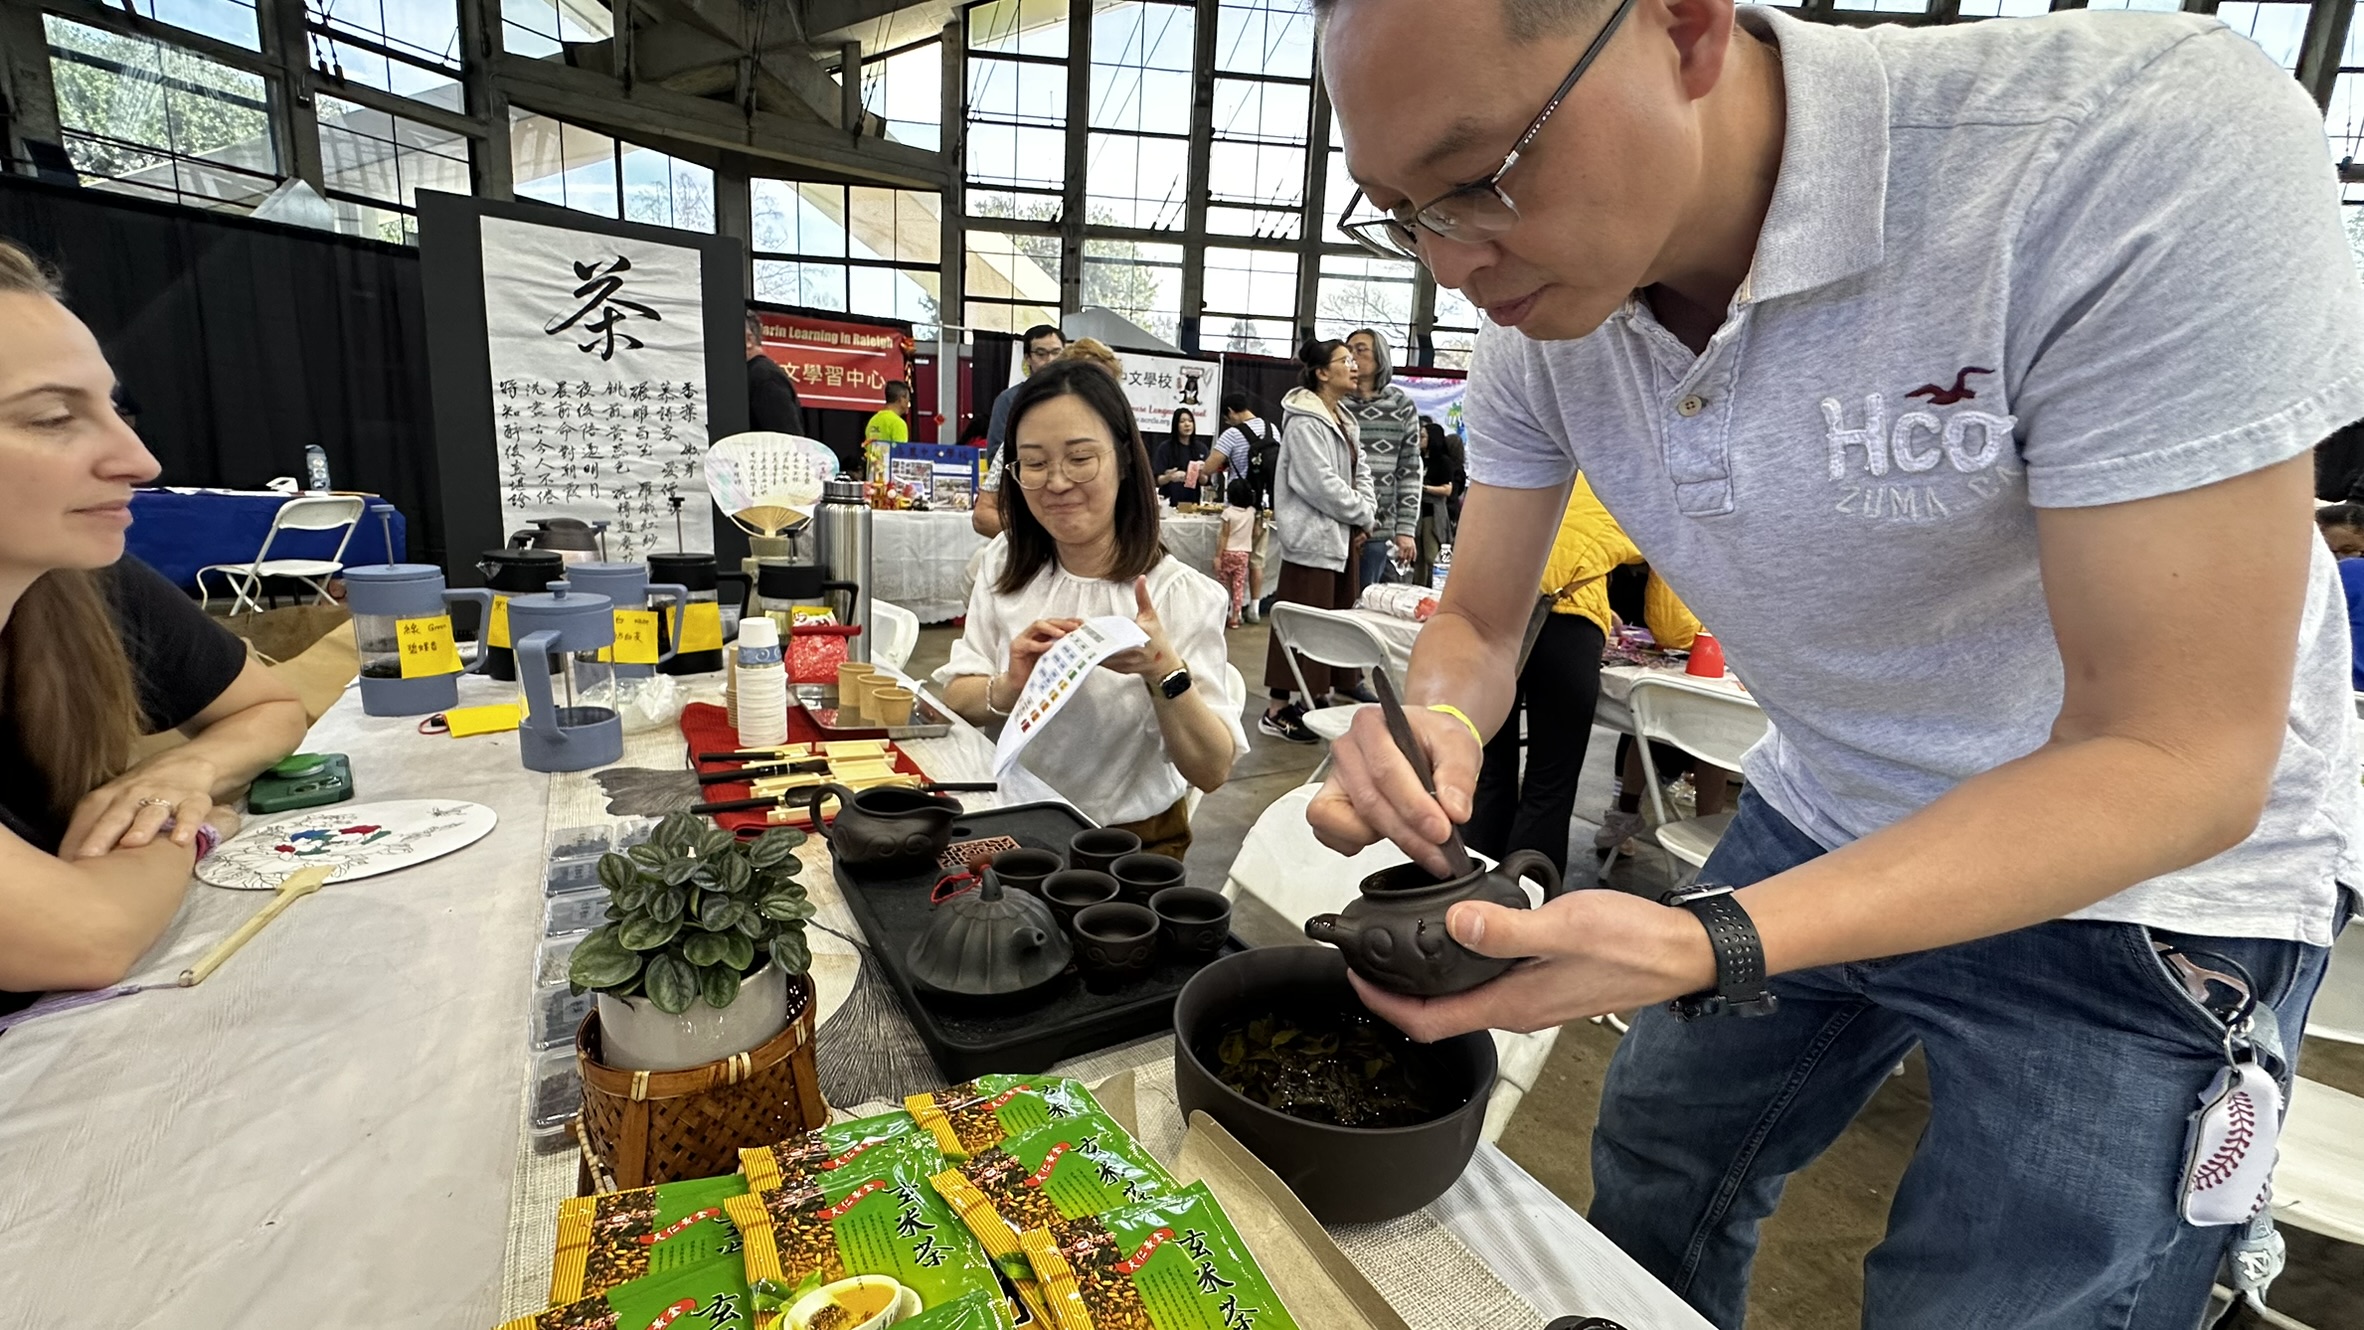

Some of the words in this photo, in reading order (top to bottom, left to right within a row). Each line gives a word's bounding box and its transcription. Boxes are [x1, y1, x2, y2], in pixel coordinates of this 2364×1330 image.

[544, 255, 662, 361] 茶
[759, 323, 787, 338] arin
[788, 326, 839, 345] Learning
[852, 333, 894, 349] Raleigh
[780, 362, 886, 390] 文學習中心
[881, 1181, 957, 1269] 玄米茶
[690, 1291, 745, 1330] 玄
[1174, 1228, 1260, 1330] 玄米茶
